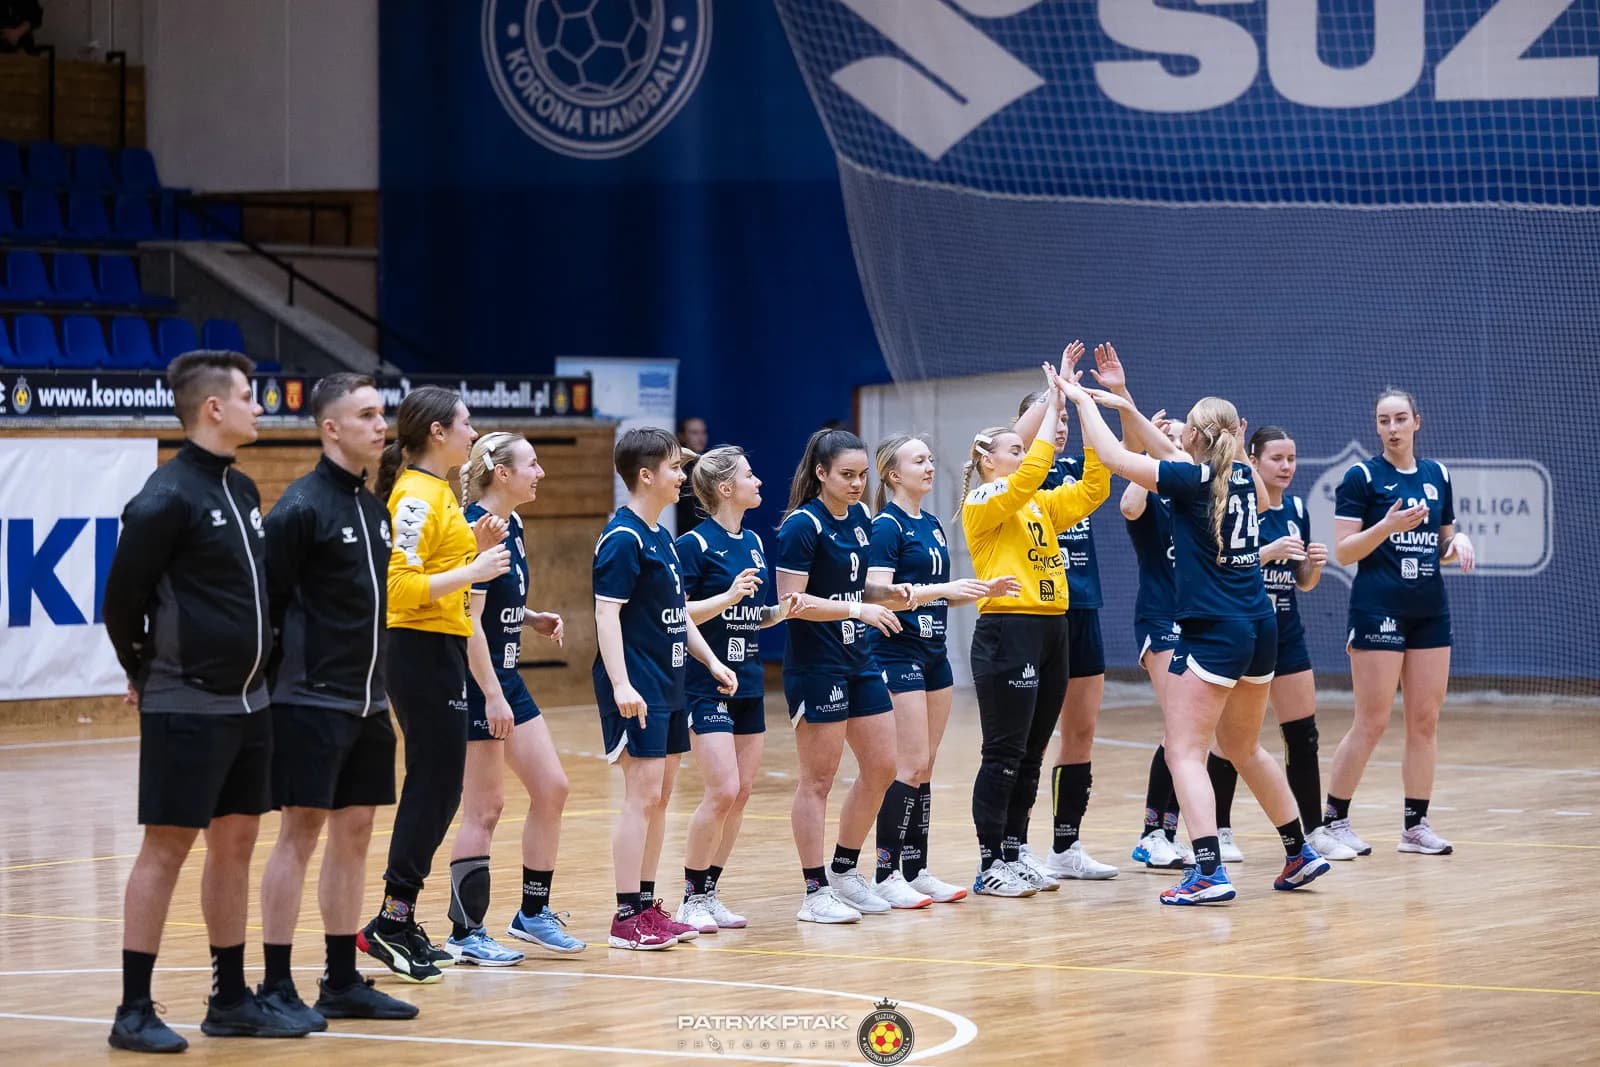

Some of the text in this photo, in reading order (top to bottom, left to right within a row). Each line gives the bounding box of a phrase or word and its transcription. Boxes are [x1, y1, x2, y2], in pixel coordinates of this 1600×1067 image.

[505, 41, 689, 136] KORONA HANDBALL
[1228, 492, 1259, 550] 24
[1460, 497, 1530, 515] RLIGA
[1028, 522, 1048, 547] 12
[0, 517, 119, 627] KI
[850, 552, 860, 582] 9
[929, 547, 943, 576] 11
[669, 564, 681, 594] 5
[722, 605, 763, 622] GLIWIC
